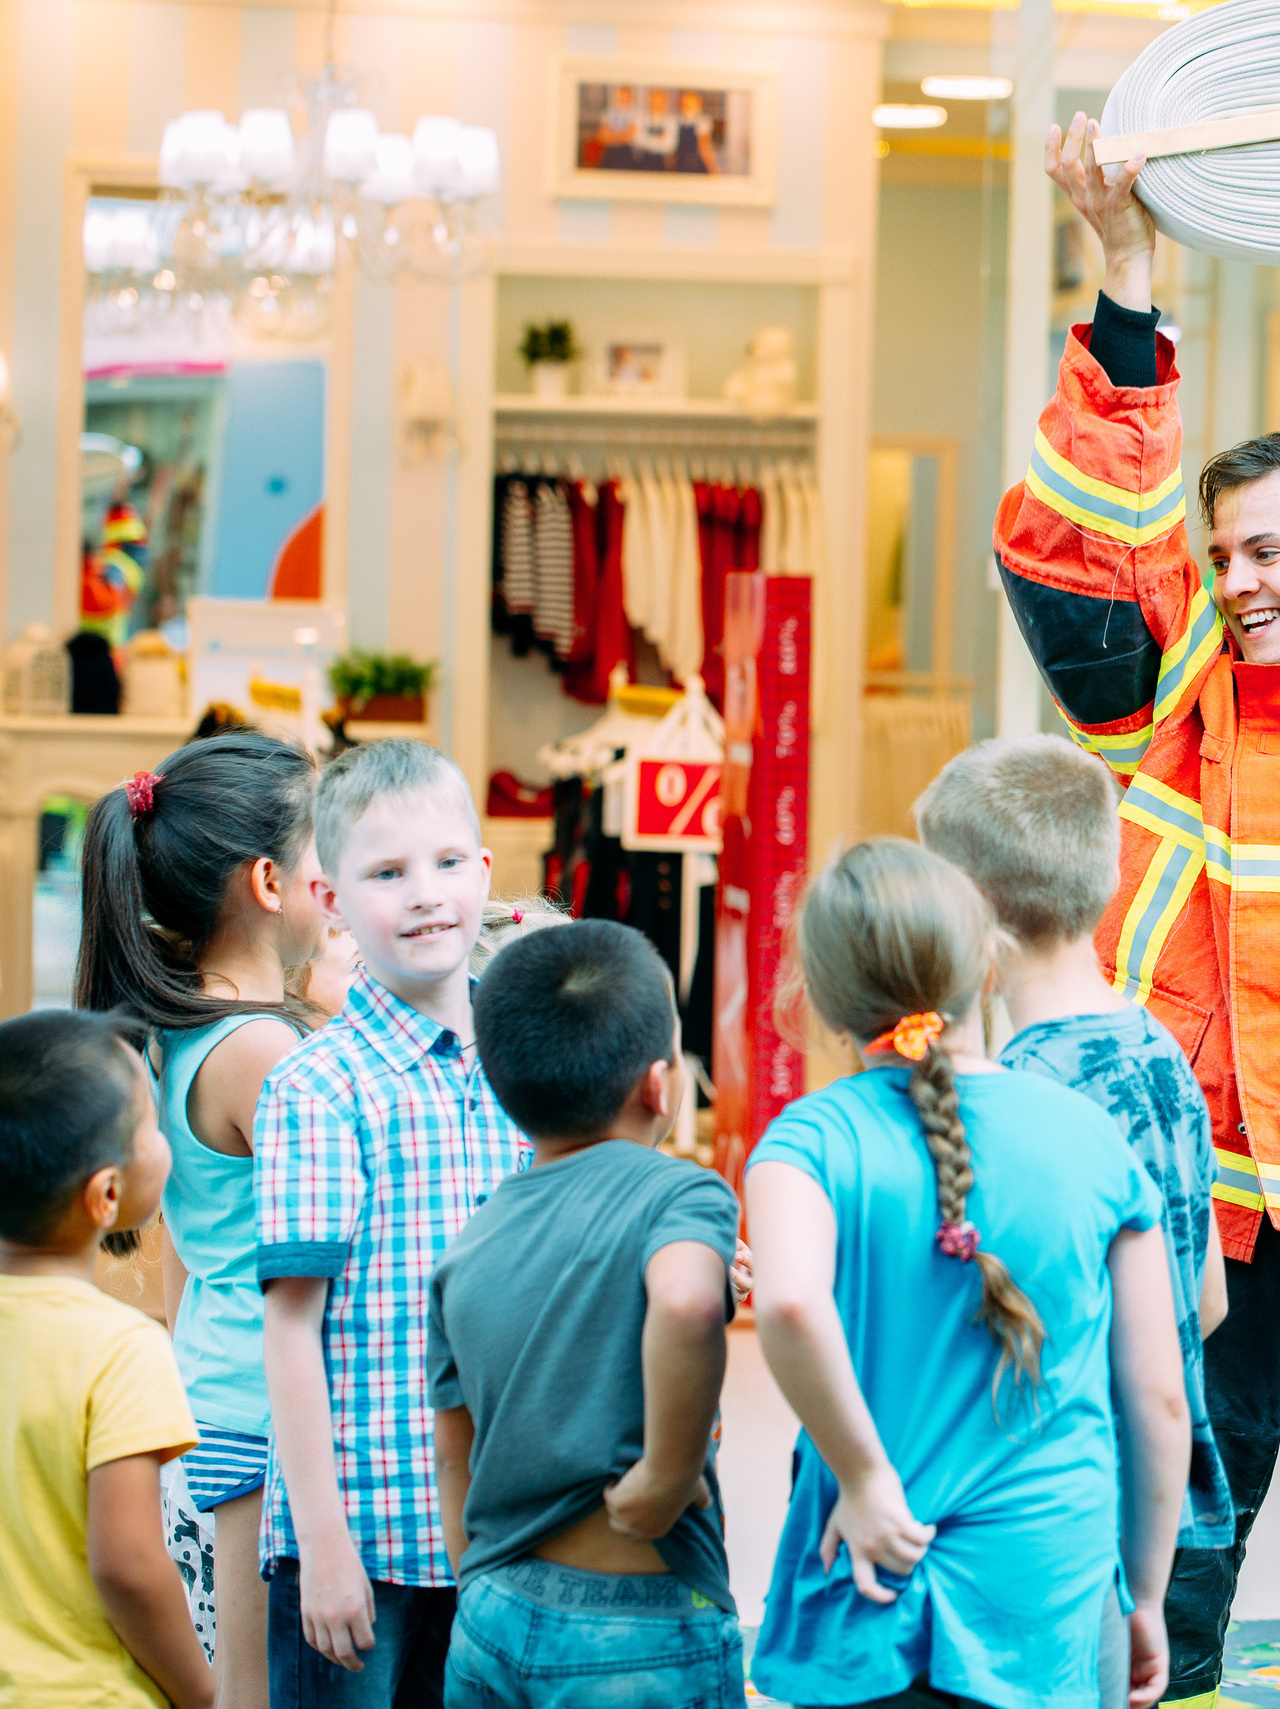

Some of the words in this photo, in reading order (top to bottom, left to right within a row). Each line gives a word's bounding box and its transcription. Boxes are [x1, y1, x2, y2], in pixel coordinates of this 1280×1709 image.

[775, 700, 797, 759] 70%
[775, 786, 796, 845] 60%
[559, 1572, 680, 1607] TEAM
